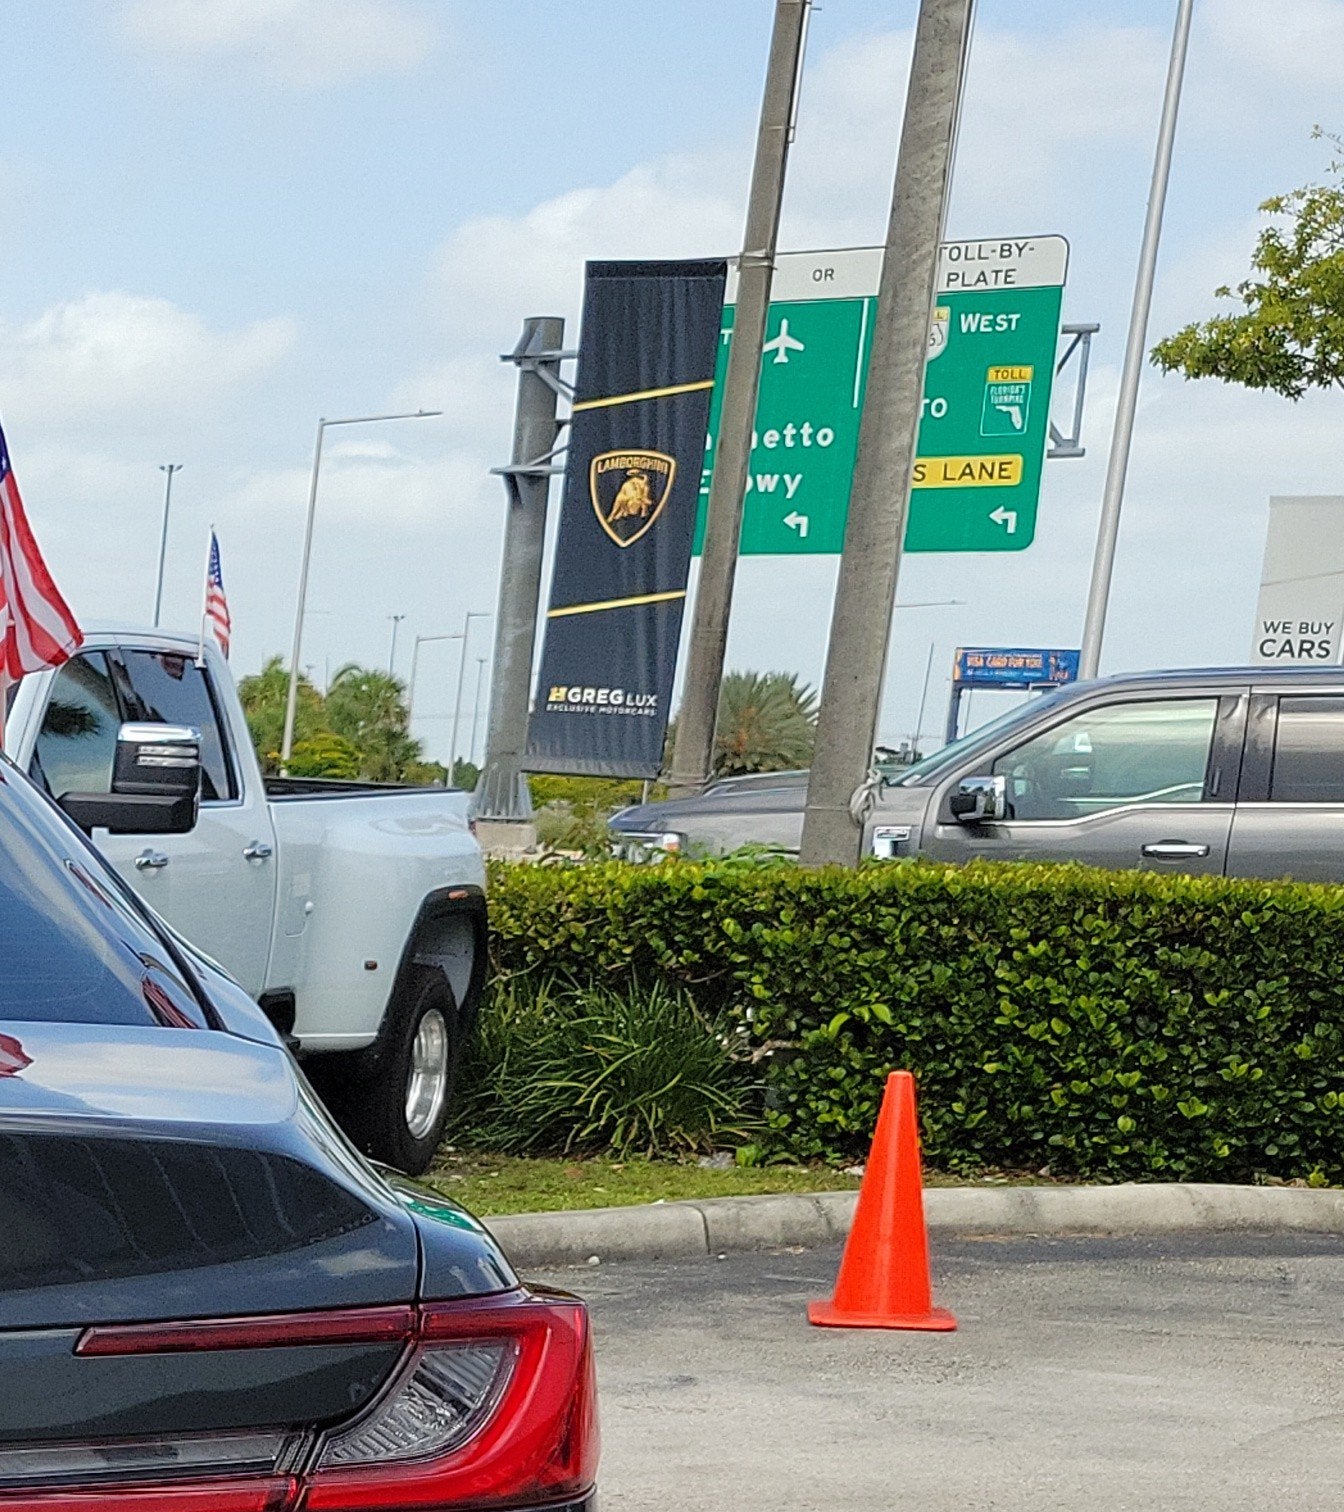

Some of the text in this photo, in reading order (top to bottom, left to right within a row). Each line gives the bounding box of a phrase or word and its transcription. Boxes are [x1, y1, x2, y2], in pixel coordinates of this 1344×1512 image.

[812, 268, 835, 282] OR
[946, 269, 1017, 288] PLATE
[960, 313, 1021, 333] WEST
[994, 367, 1027, 380] TOLL
[942, 461, 1014, 481] LANE
[1263, 621, 1334, 635] WE BUY
[1259, 638, 1331, 659] CARS
[626, 693, 658, 707] LUX
